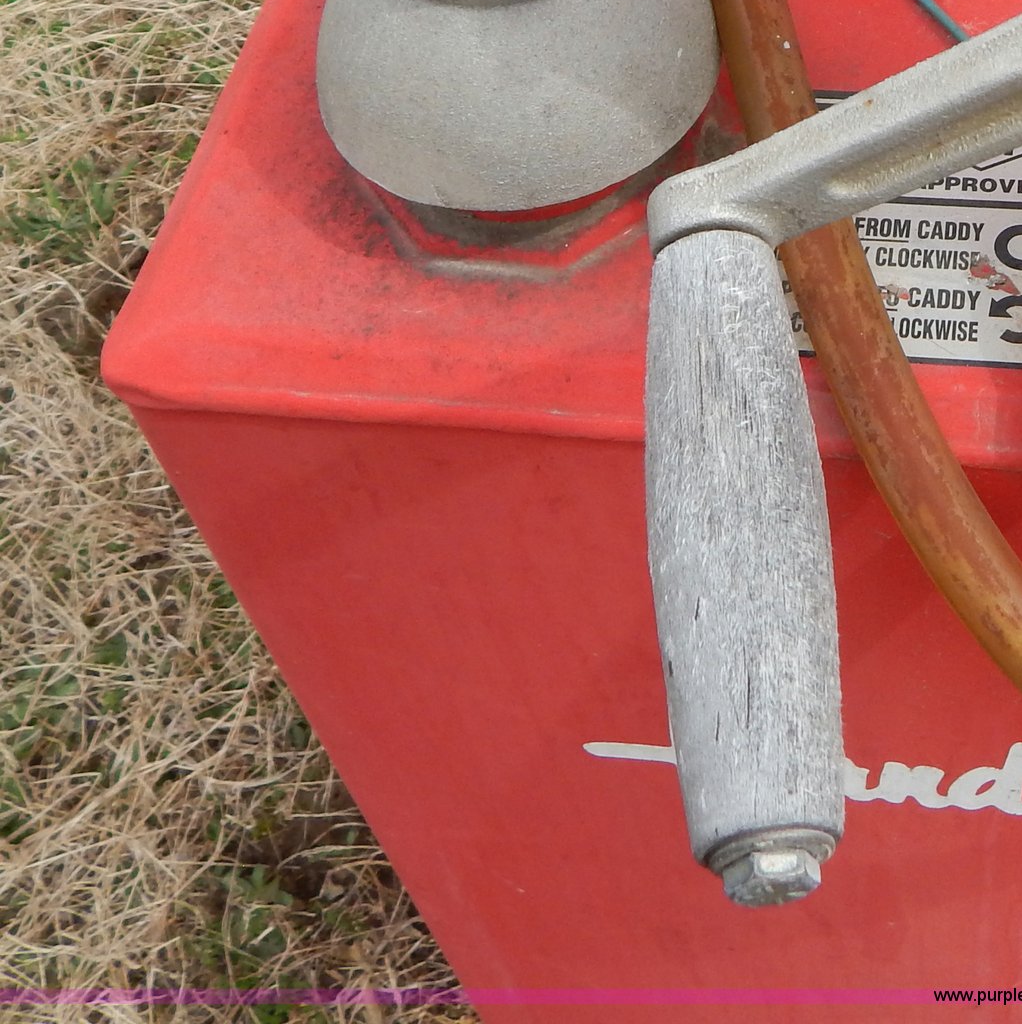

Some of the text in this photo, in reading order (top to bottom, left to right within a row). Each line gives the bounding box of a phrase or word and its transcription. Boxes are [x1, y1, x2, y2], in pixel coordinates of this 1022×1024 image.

[855, 217, 985, 242] FROM CADDY
[907, 287, 981, 311] CADDY
